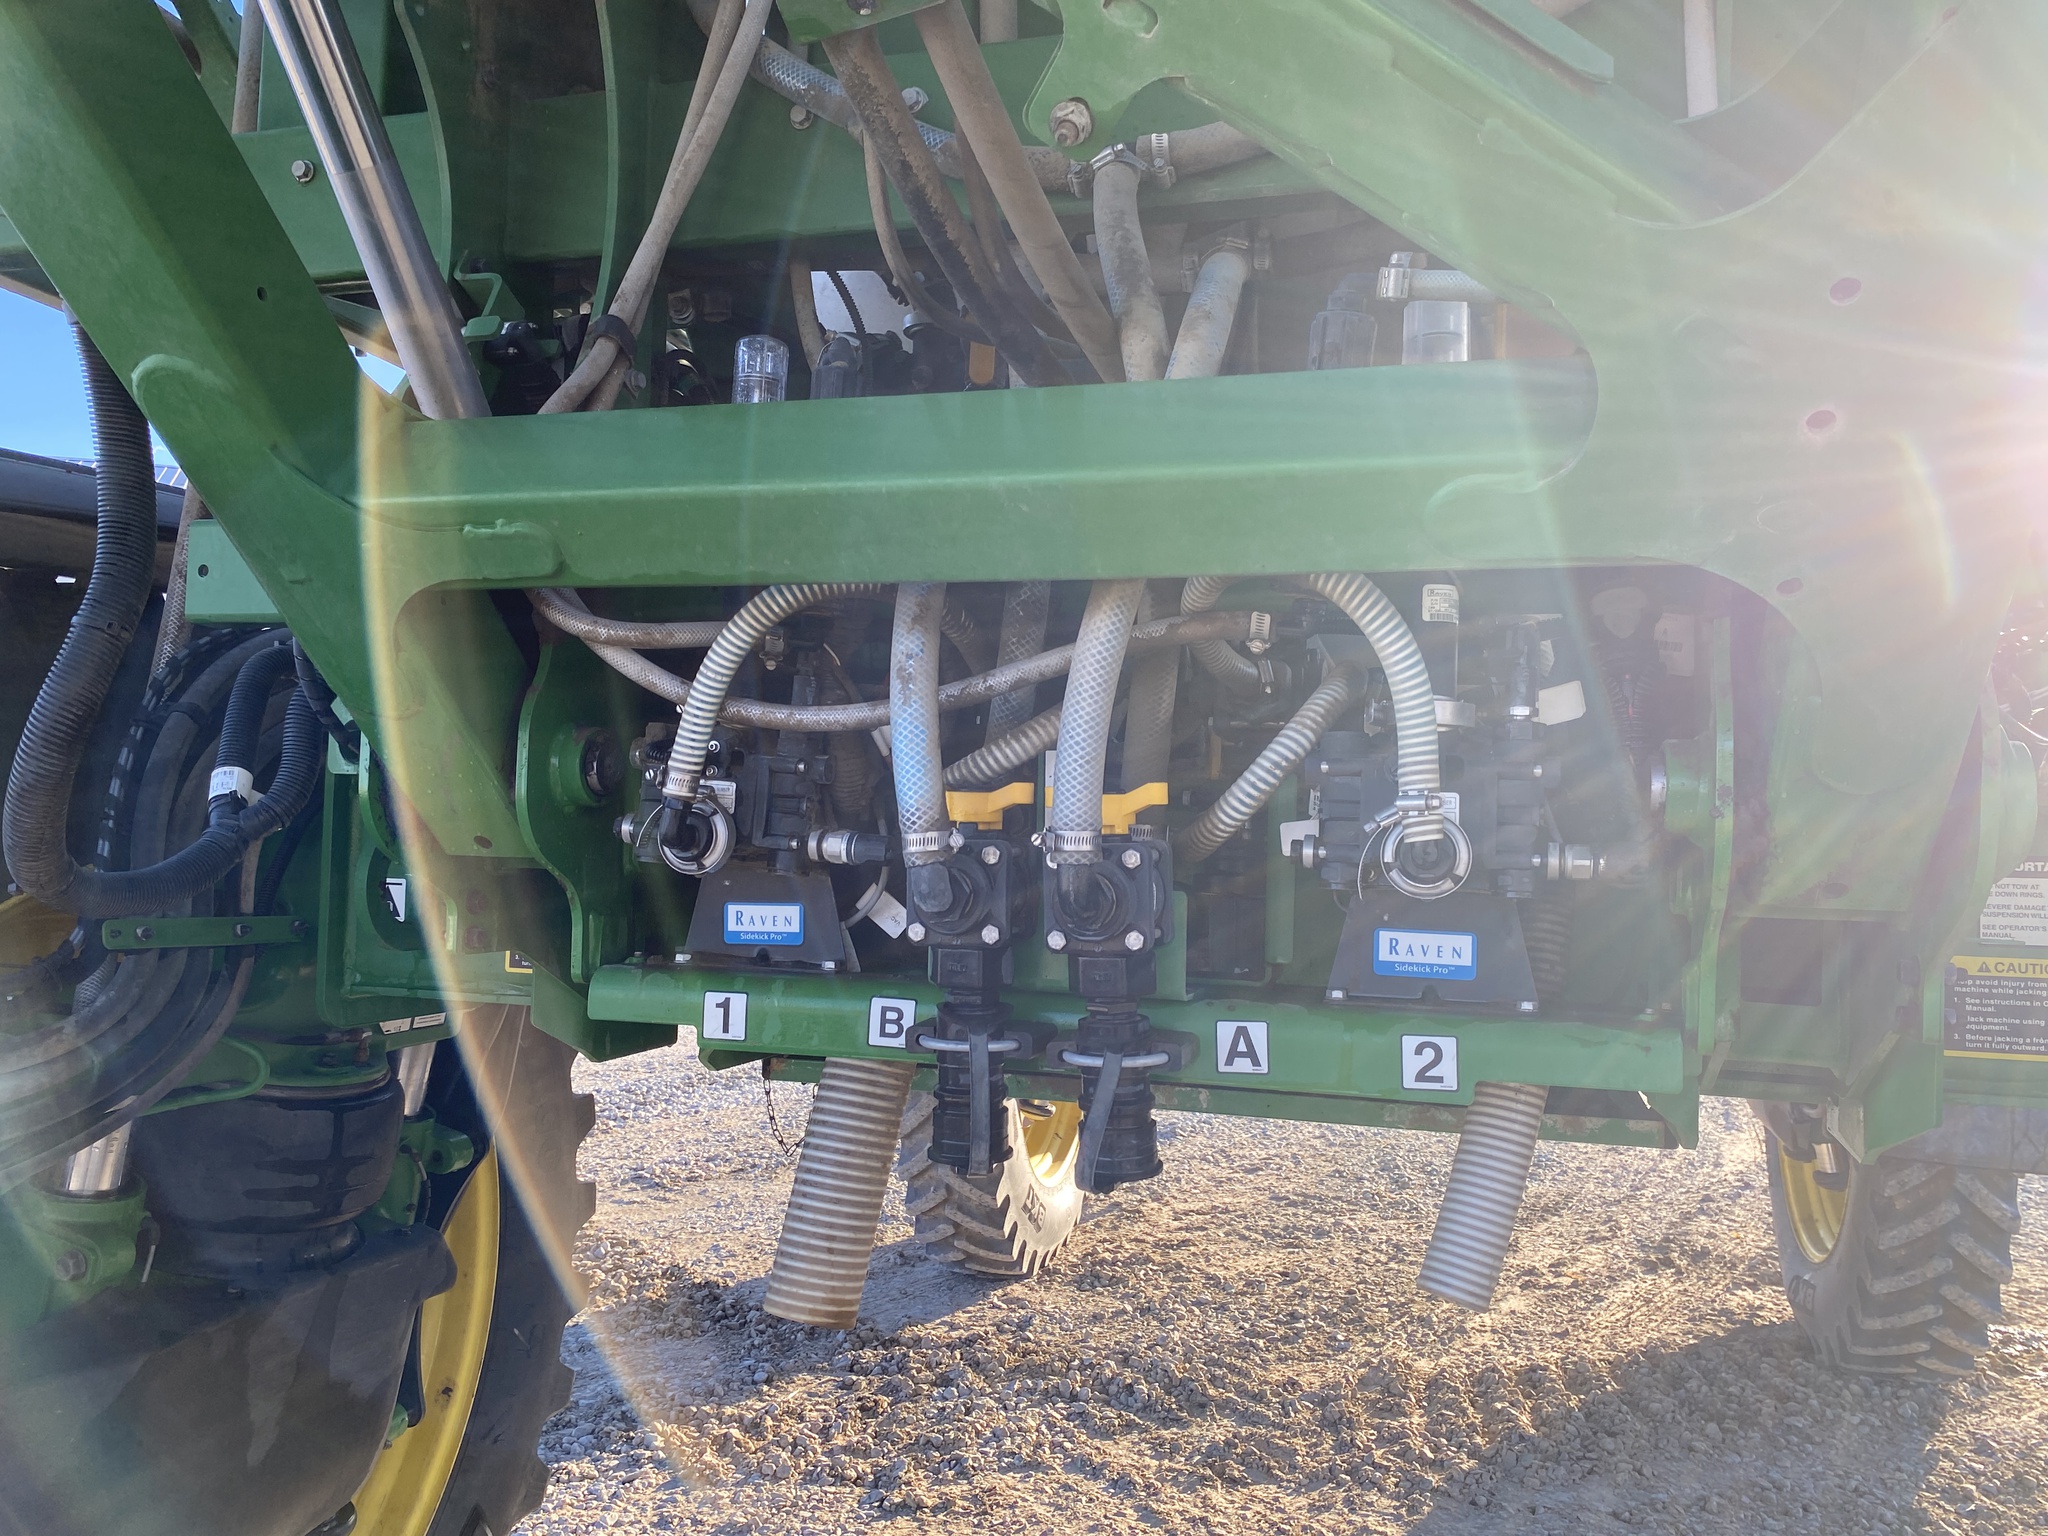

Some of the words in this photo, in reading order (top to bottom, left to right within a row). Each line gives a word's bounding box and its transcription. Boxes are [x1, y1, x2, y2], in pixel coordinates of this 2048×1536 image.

[735, 910, 792, 927] RAVEN
[1982, 911, 2029, 919] SUSPENSION
[1999, 924, 2047, 932] OPERATOR'S
[740, 932, 770, 940] Sidekick
[1389, 937, 1462, 959] RAVEN
[1394, 963, 1431, 973] Sidekick
[2001, 979, 2025, 988] injury
[2027, 980, 2047, 988] from
[2016, 988, 2047, 997] jacking
[1982, 998, 2031, 1006] instructions
[715, 996, 731, 1034] 1
[879, 1005, 905, 1038] B
[1986, 1016, 2020, 1024] machine
[2022, 1018, 2045, 1027] using
[1994, 1035, 2023, 1044] jacking
[1223, 1025, 1262, 1068] A
[1992, 1042, 2009, 1050] fully
[2012, 1043, 2048, 1052] outward.
[1414, 1041, 1444, 1084] 2
